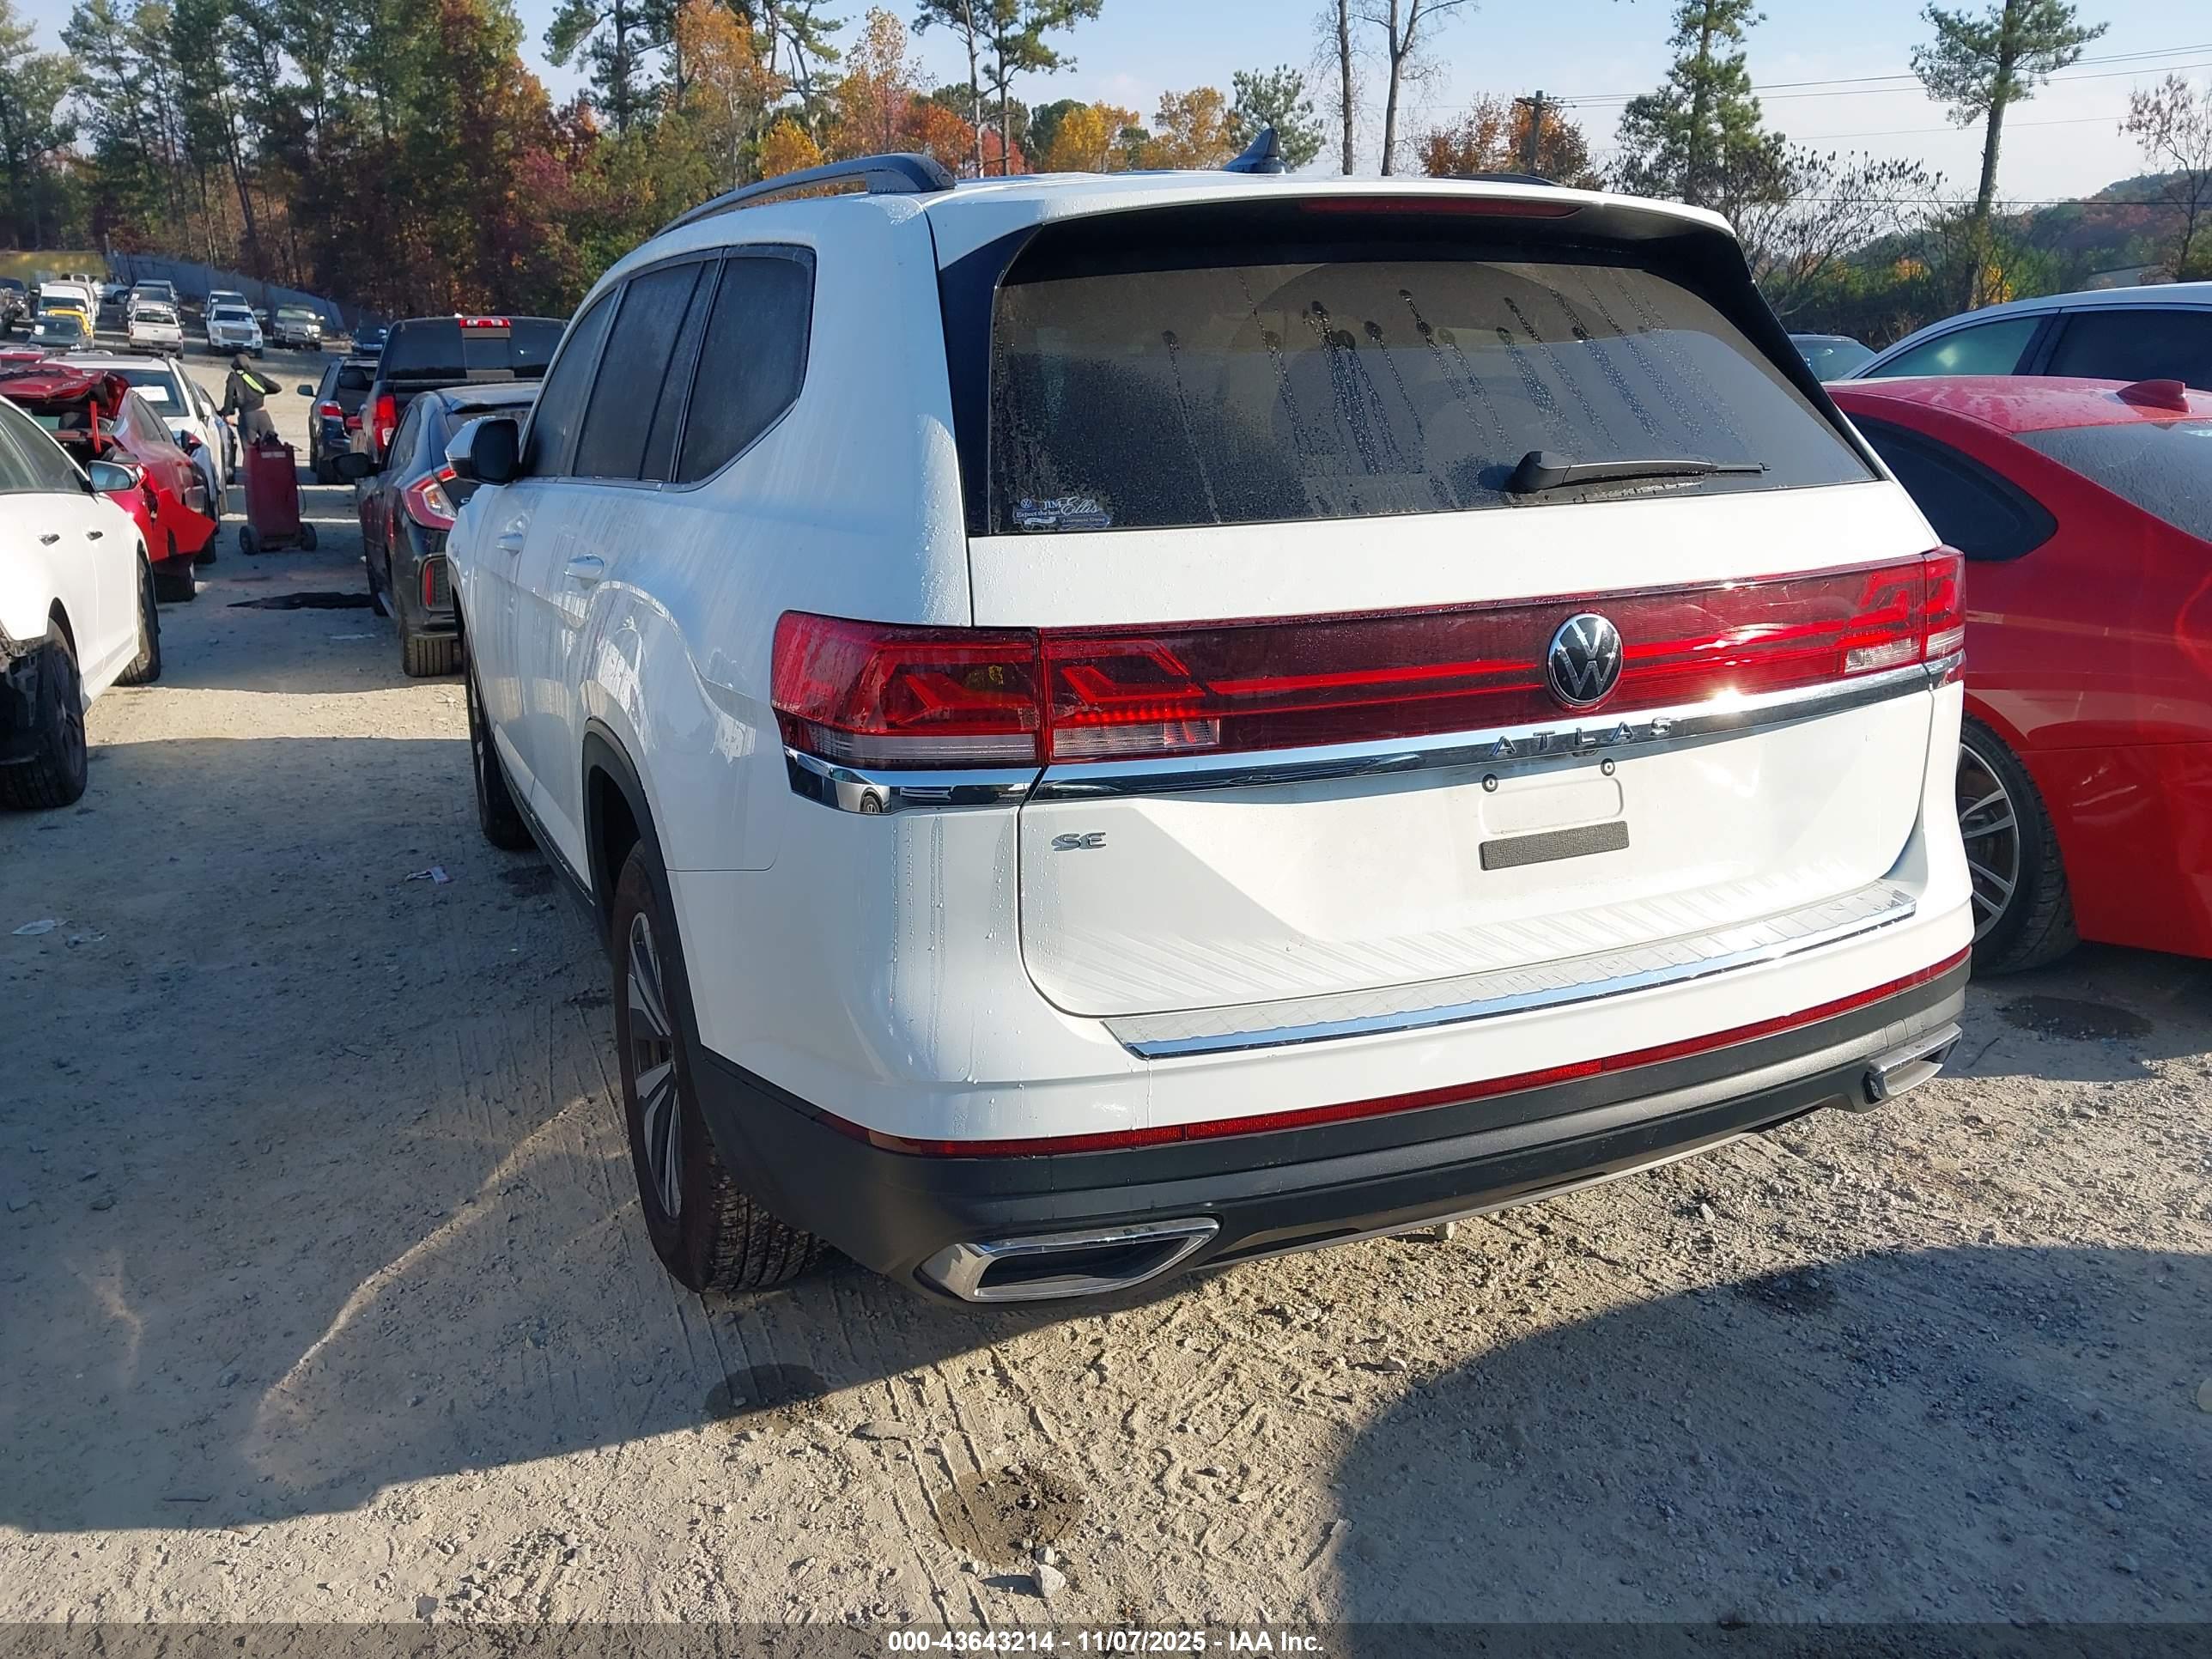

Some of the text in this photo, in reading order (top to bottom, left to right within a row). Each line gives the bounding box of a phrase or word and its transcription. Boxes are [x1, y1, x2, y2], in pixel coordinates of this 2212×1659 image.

[1043, 496, 1099, 515] JIM Ellis
[1489, 716, 1672, 756] ATLAS
[1050, 831, 1107, 852] SE
